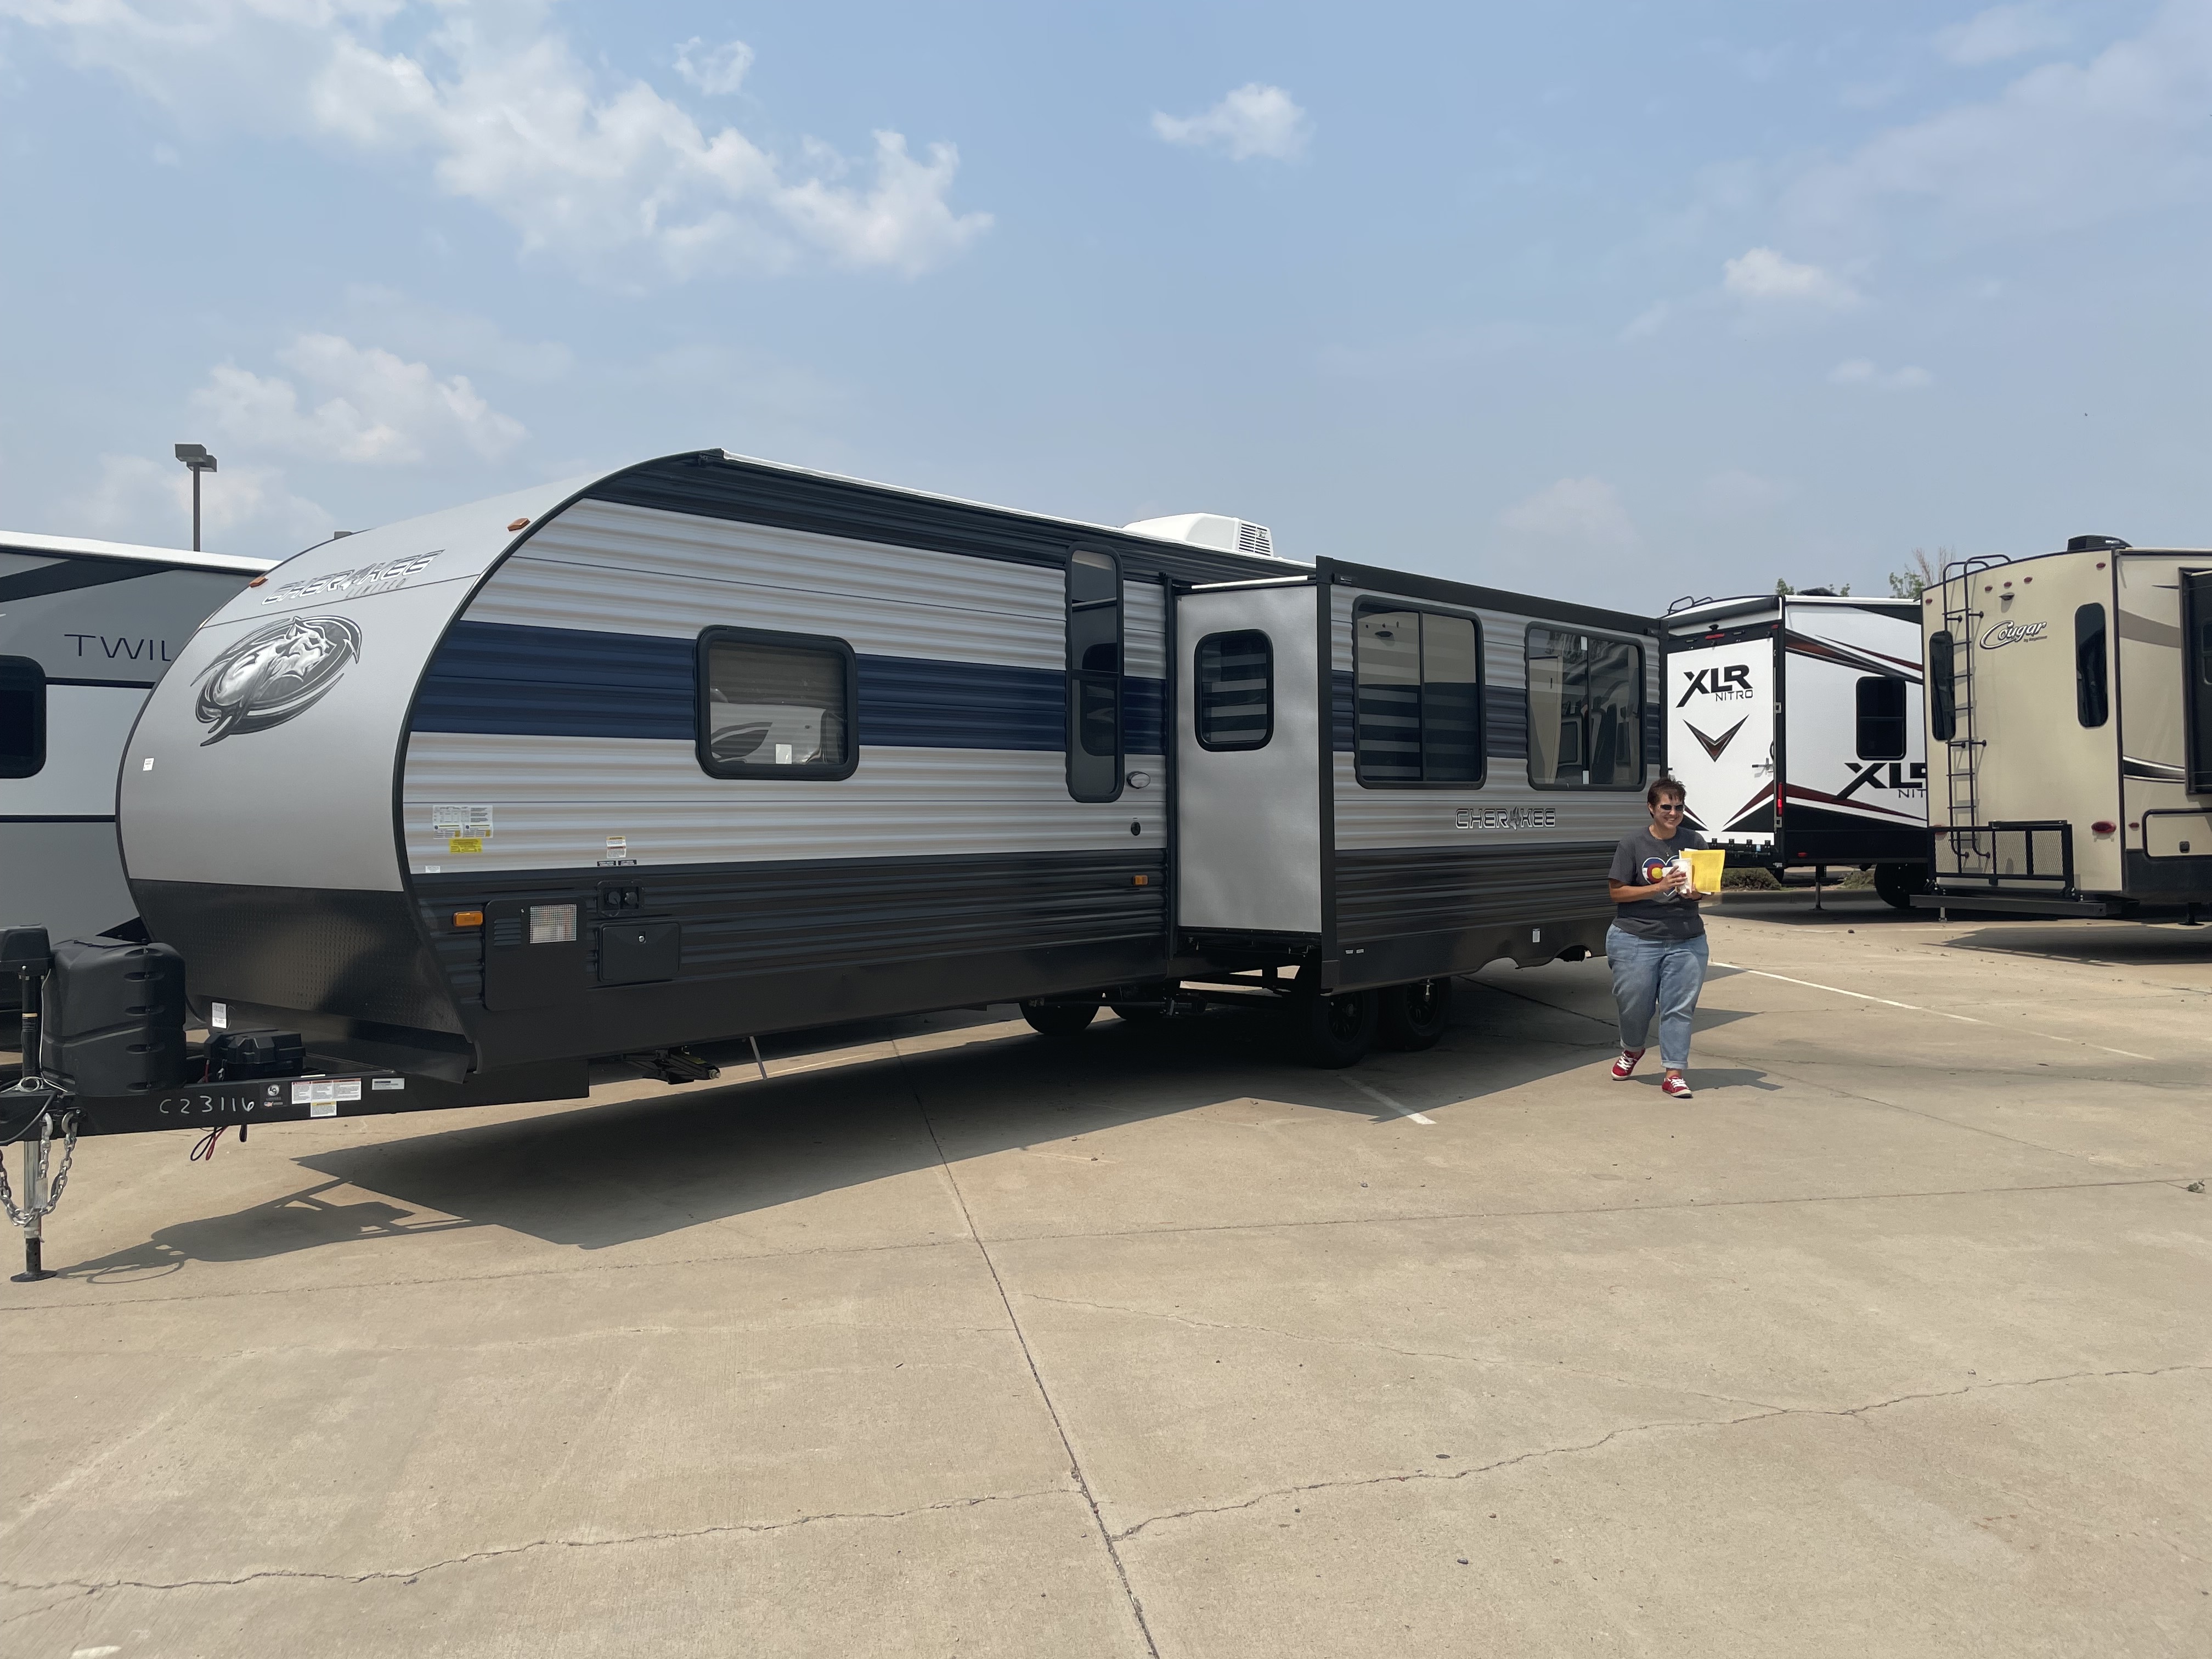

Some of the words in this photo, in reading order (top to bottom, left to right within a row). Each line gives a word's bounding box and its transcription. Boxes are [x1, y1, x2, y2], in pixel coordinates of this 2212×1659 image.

[64, 634, 171, 661] TWIL
[1979, 620, 2047, 650] Cougar
[1675, 664, 1753, 708] XLR
[1716, 689, 1753, 702] NITRO
